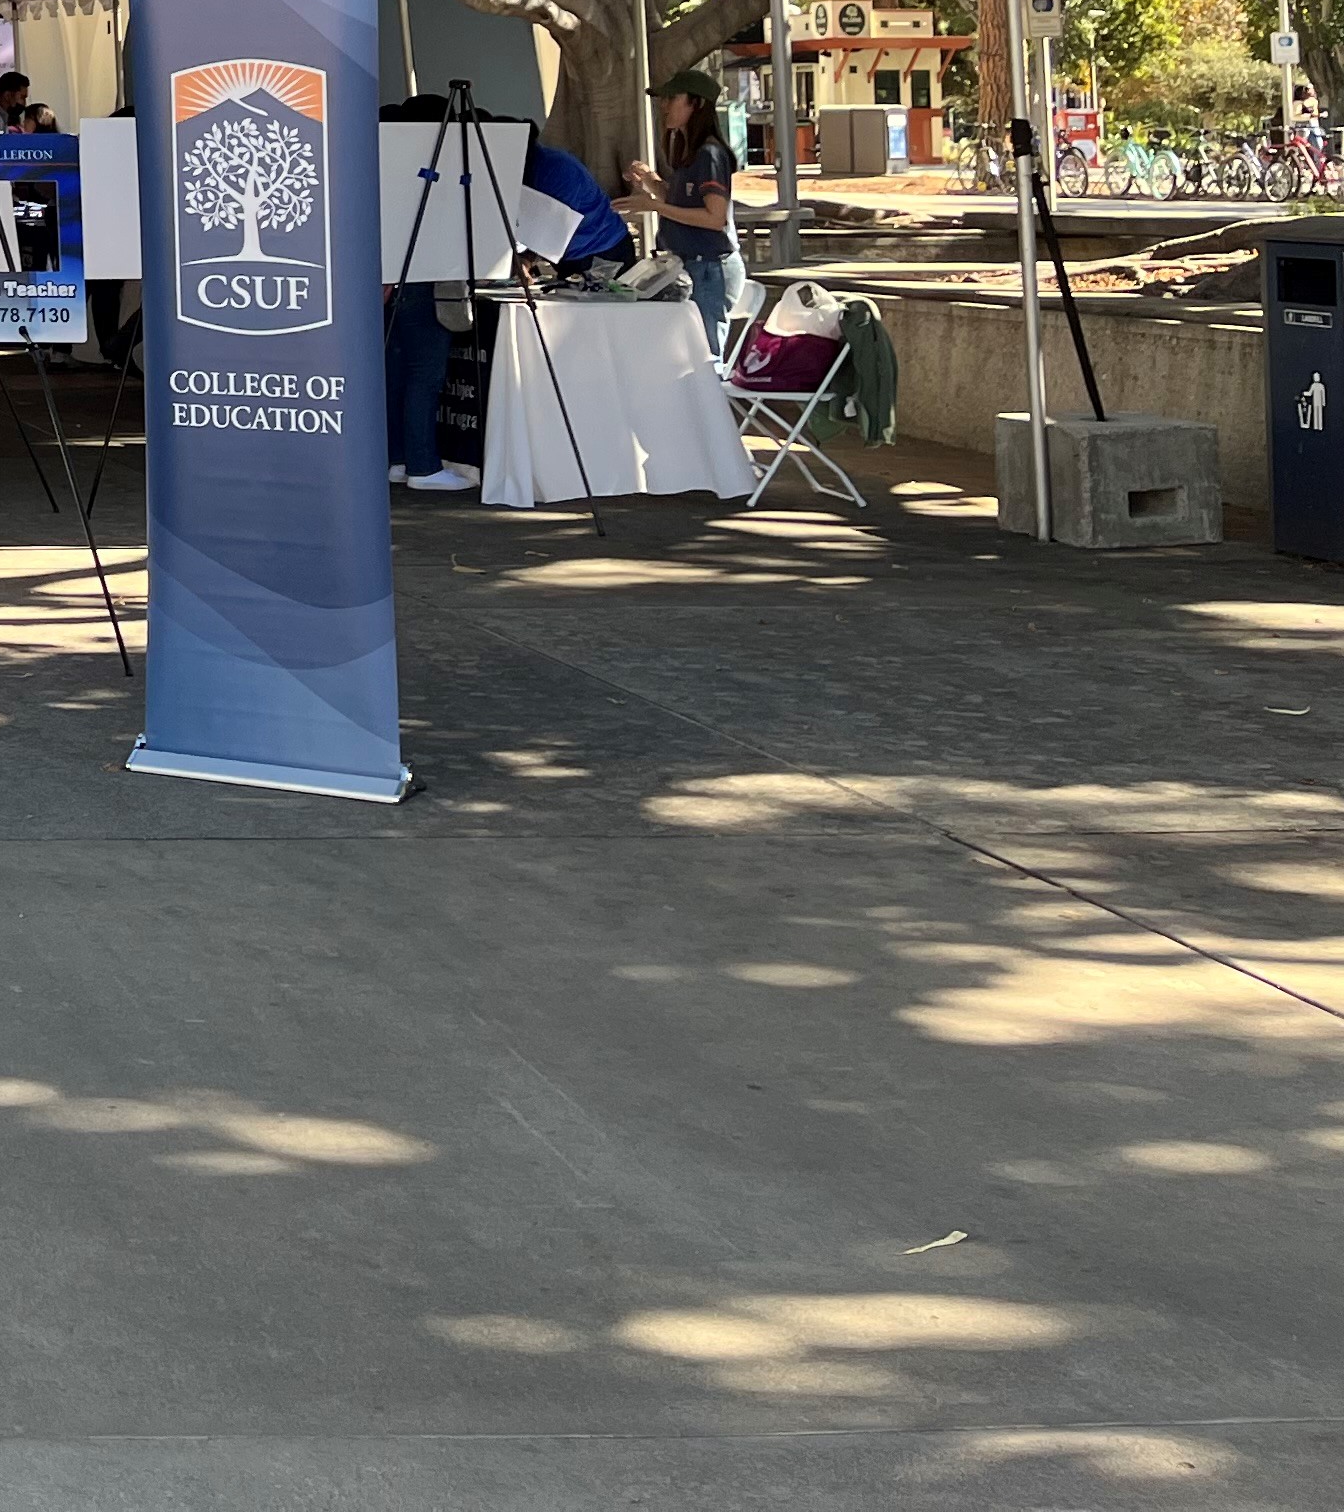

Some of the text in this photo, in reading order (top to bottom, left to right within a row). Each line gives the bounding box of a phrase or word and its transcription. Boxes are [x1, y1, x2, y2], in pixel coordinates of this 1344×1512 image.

[3, 281, 76, 298] Teacher
[197, 274, 310, 310] CSUF
[169, 369, 346, 401] COLLEGE OF
[172, 403, 344, 435] EDUCATION
